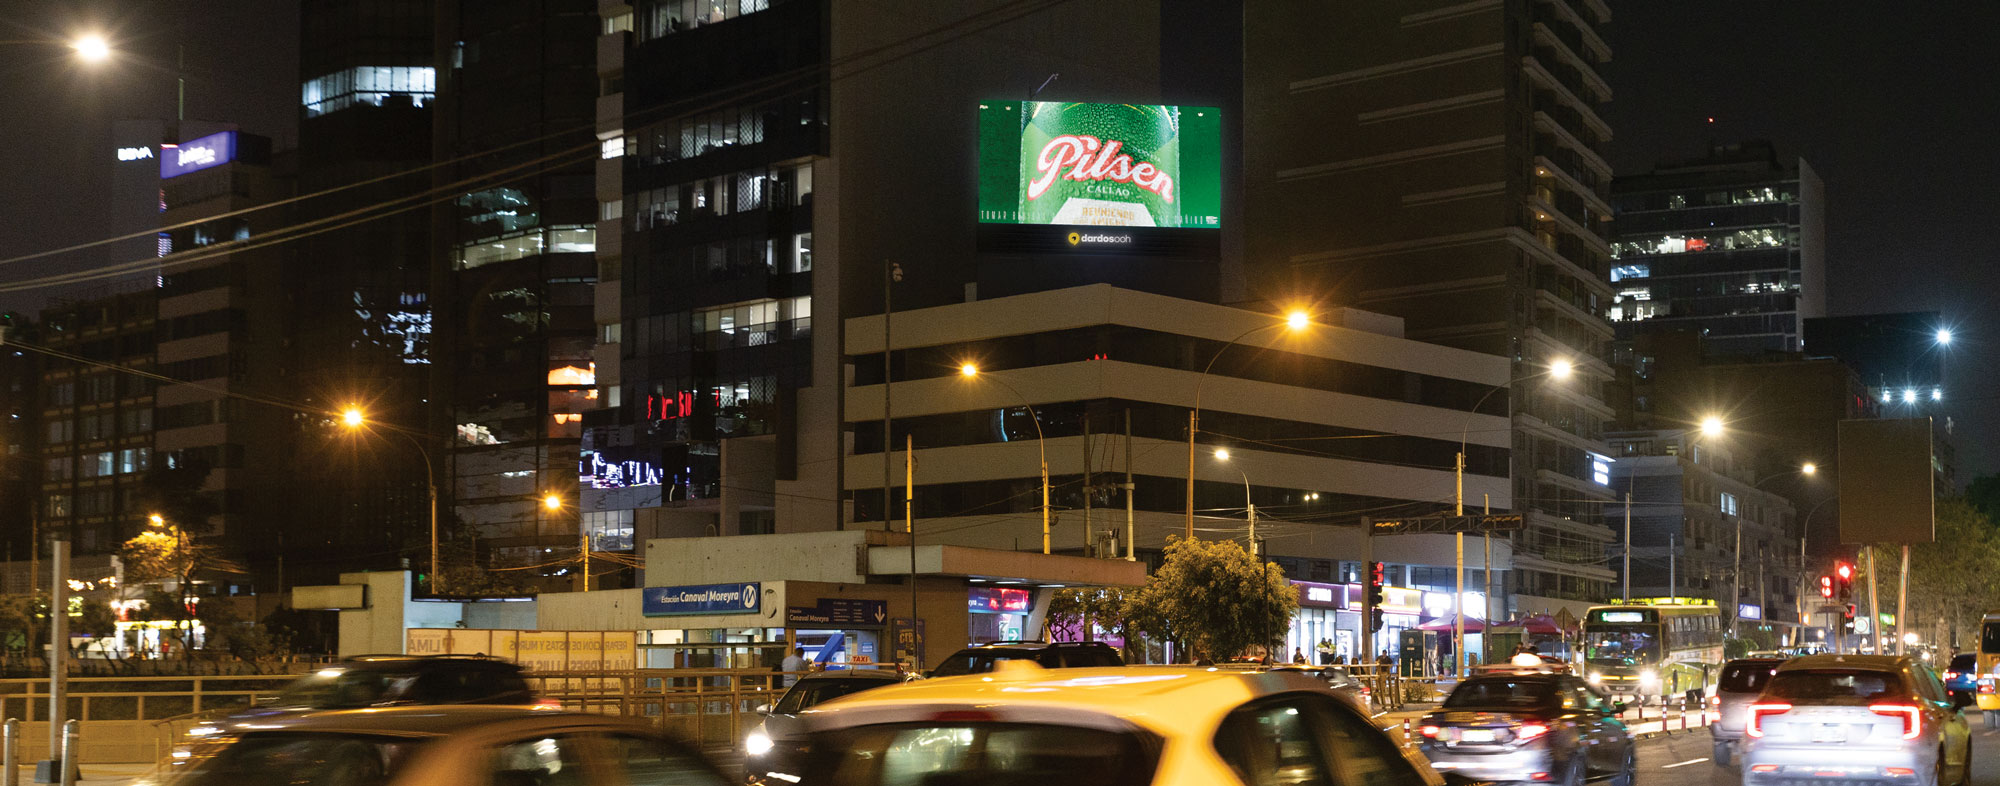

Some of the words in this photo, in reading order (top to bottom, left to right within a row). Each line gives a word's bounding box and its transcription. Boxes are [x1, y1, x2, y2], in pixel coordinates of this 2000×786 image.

[1027, 135, 1174, 203] Pilsen
[1087, 185, 1130, 197] CALLAO
[680, 591, 708, 602] Canaval
[709, 590, 739, 604] Moreyra
